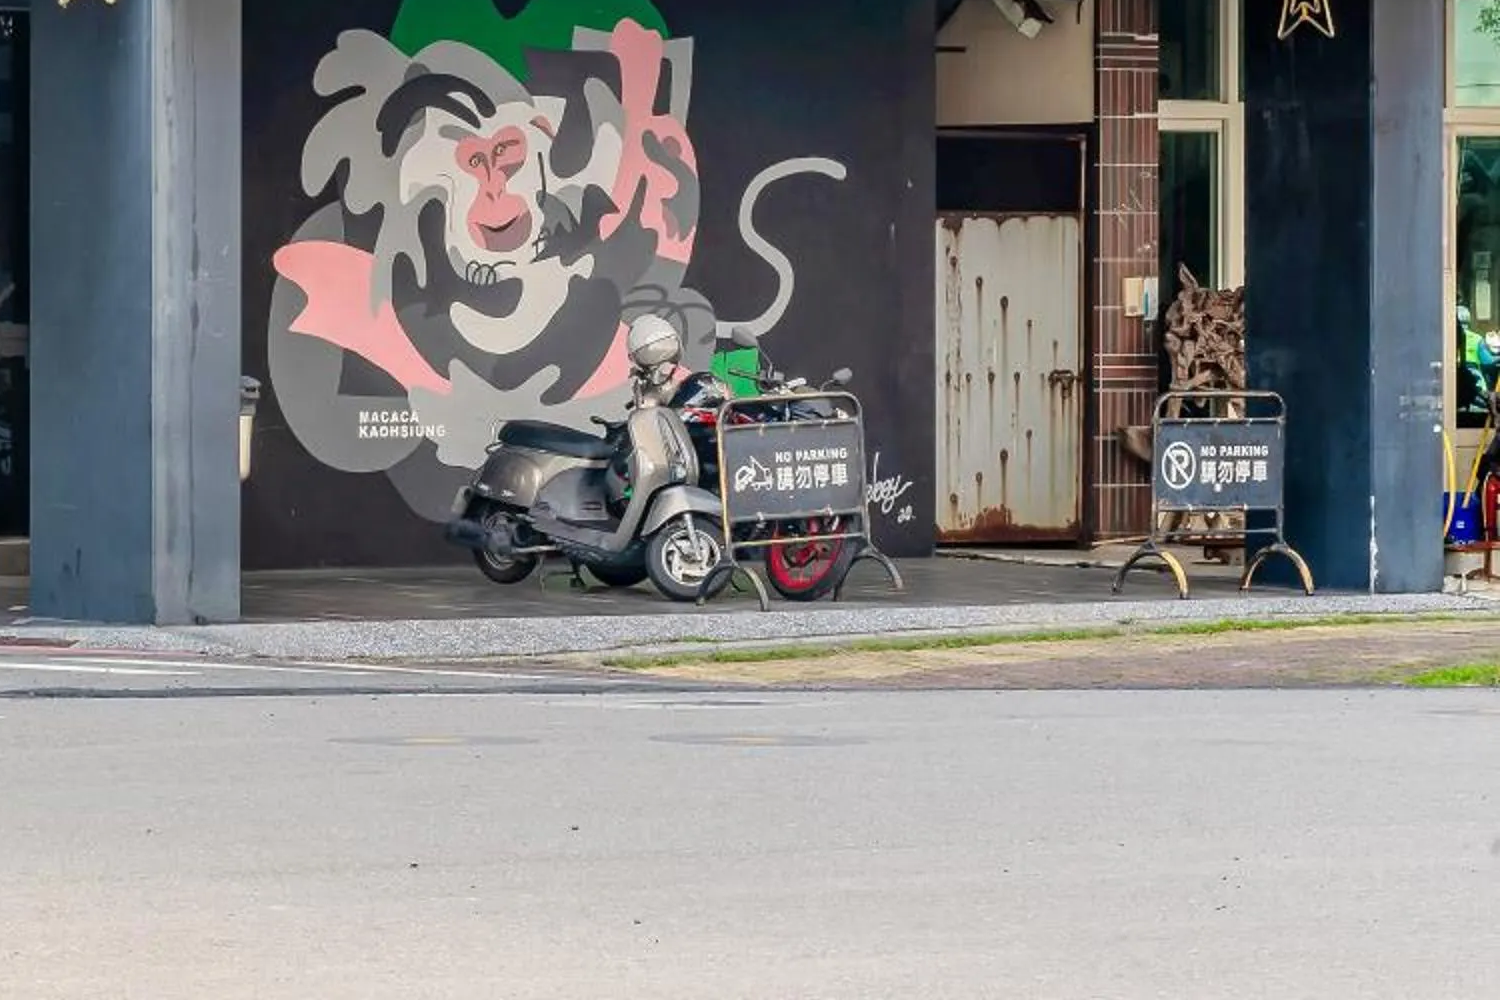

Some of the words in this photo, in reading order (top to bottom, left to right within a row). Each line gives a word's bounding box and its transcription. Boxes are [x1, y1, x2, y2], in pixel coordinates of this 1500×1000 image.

[359, 411, 420, 423] MACACA
[359, 425, 446, 438] KAOHSIUNG
[775, 451, 792, 463] NO
[796, 447, 848, 461] PARKING
[1201, 446, 1217, 457] NO
[1219, 446, 1269, 457] PARKING
[776, 463, 848, 491] 請勿停車
[1201, 460, 1267, 484] 請勿停車
